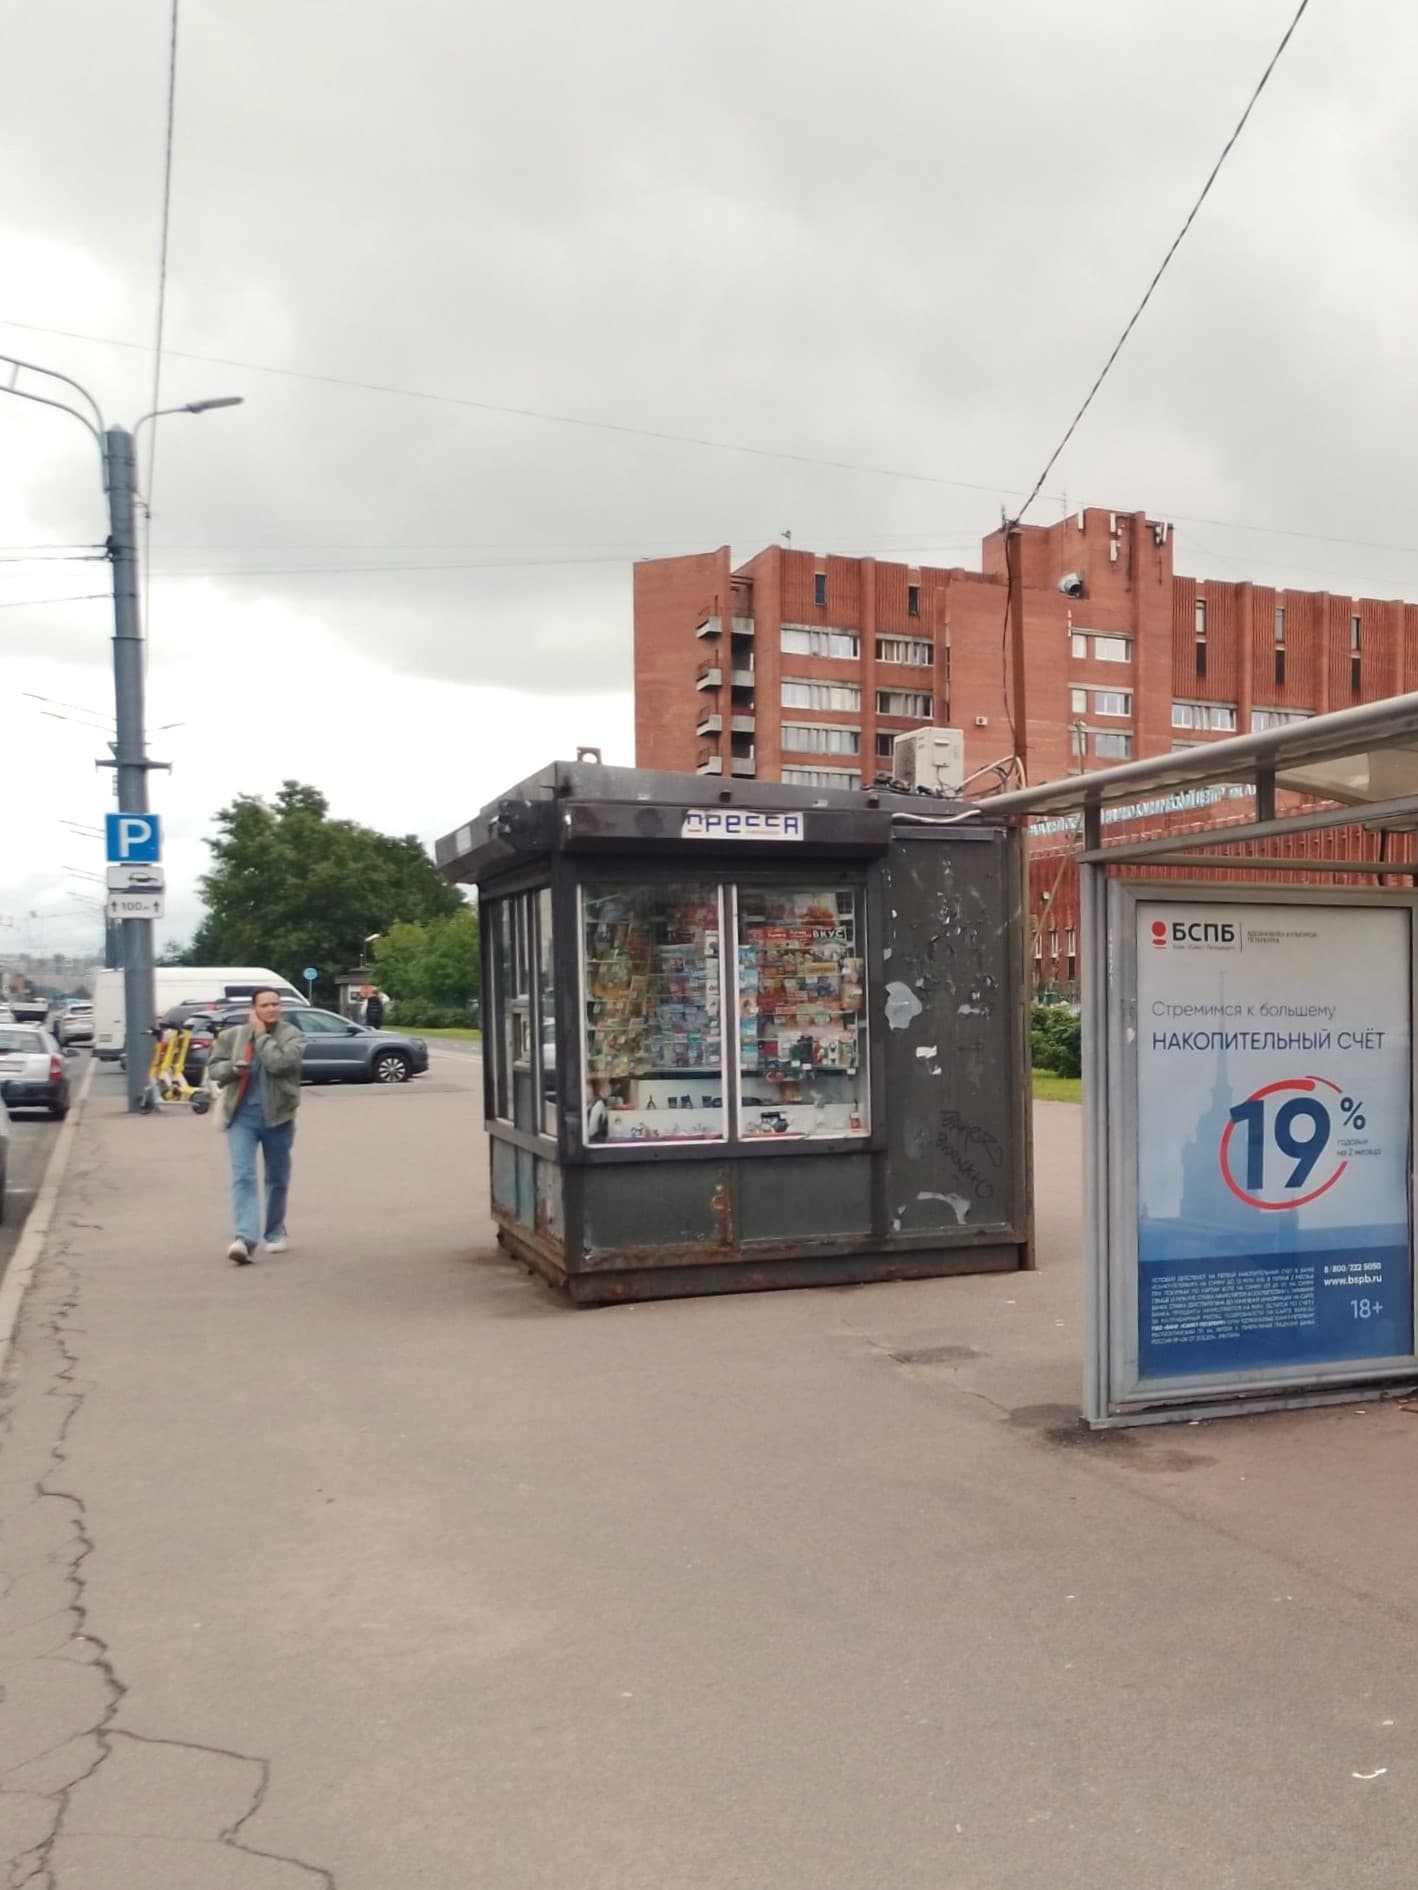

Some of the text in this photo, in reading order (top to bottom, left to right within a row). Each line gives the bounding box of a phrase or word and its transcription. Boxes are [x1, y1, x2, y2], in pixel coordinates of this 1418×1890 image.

[119, 818, 152, 858] P
[812, 929, 844, 939] ВКУС
[1172, 922, 1235, 942] БСПБ
[1151, 1001, 1336, 1020] Стремимся к большему
[1152, 1028, 1385, 1050] НАКОПИТЕЛЬНЫЙ СЧЁТ
[1324, 1274, 1382, 1286] www.bspb.ru
[1350, 1299, 1383, 1319] 18+
